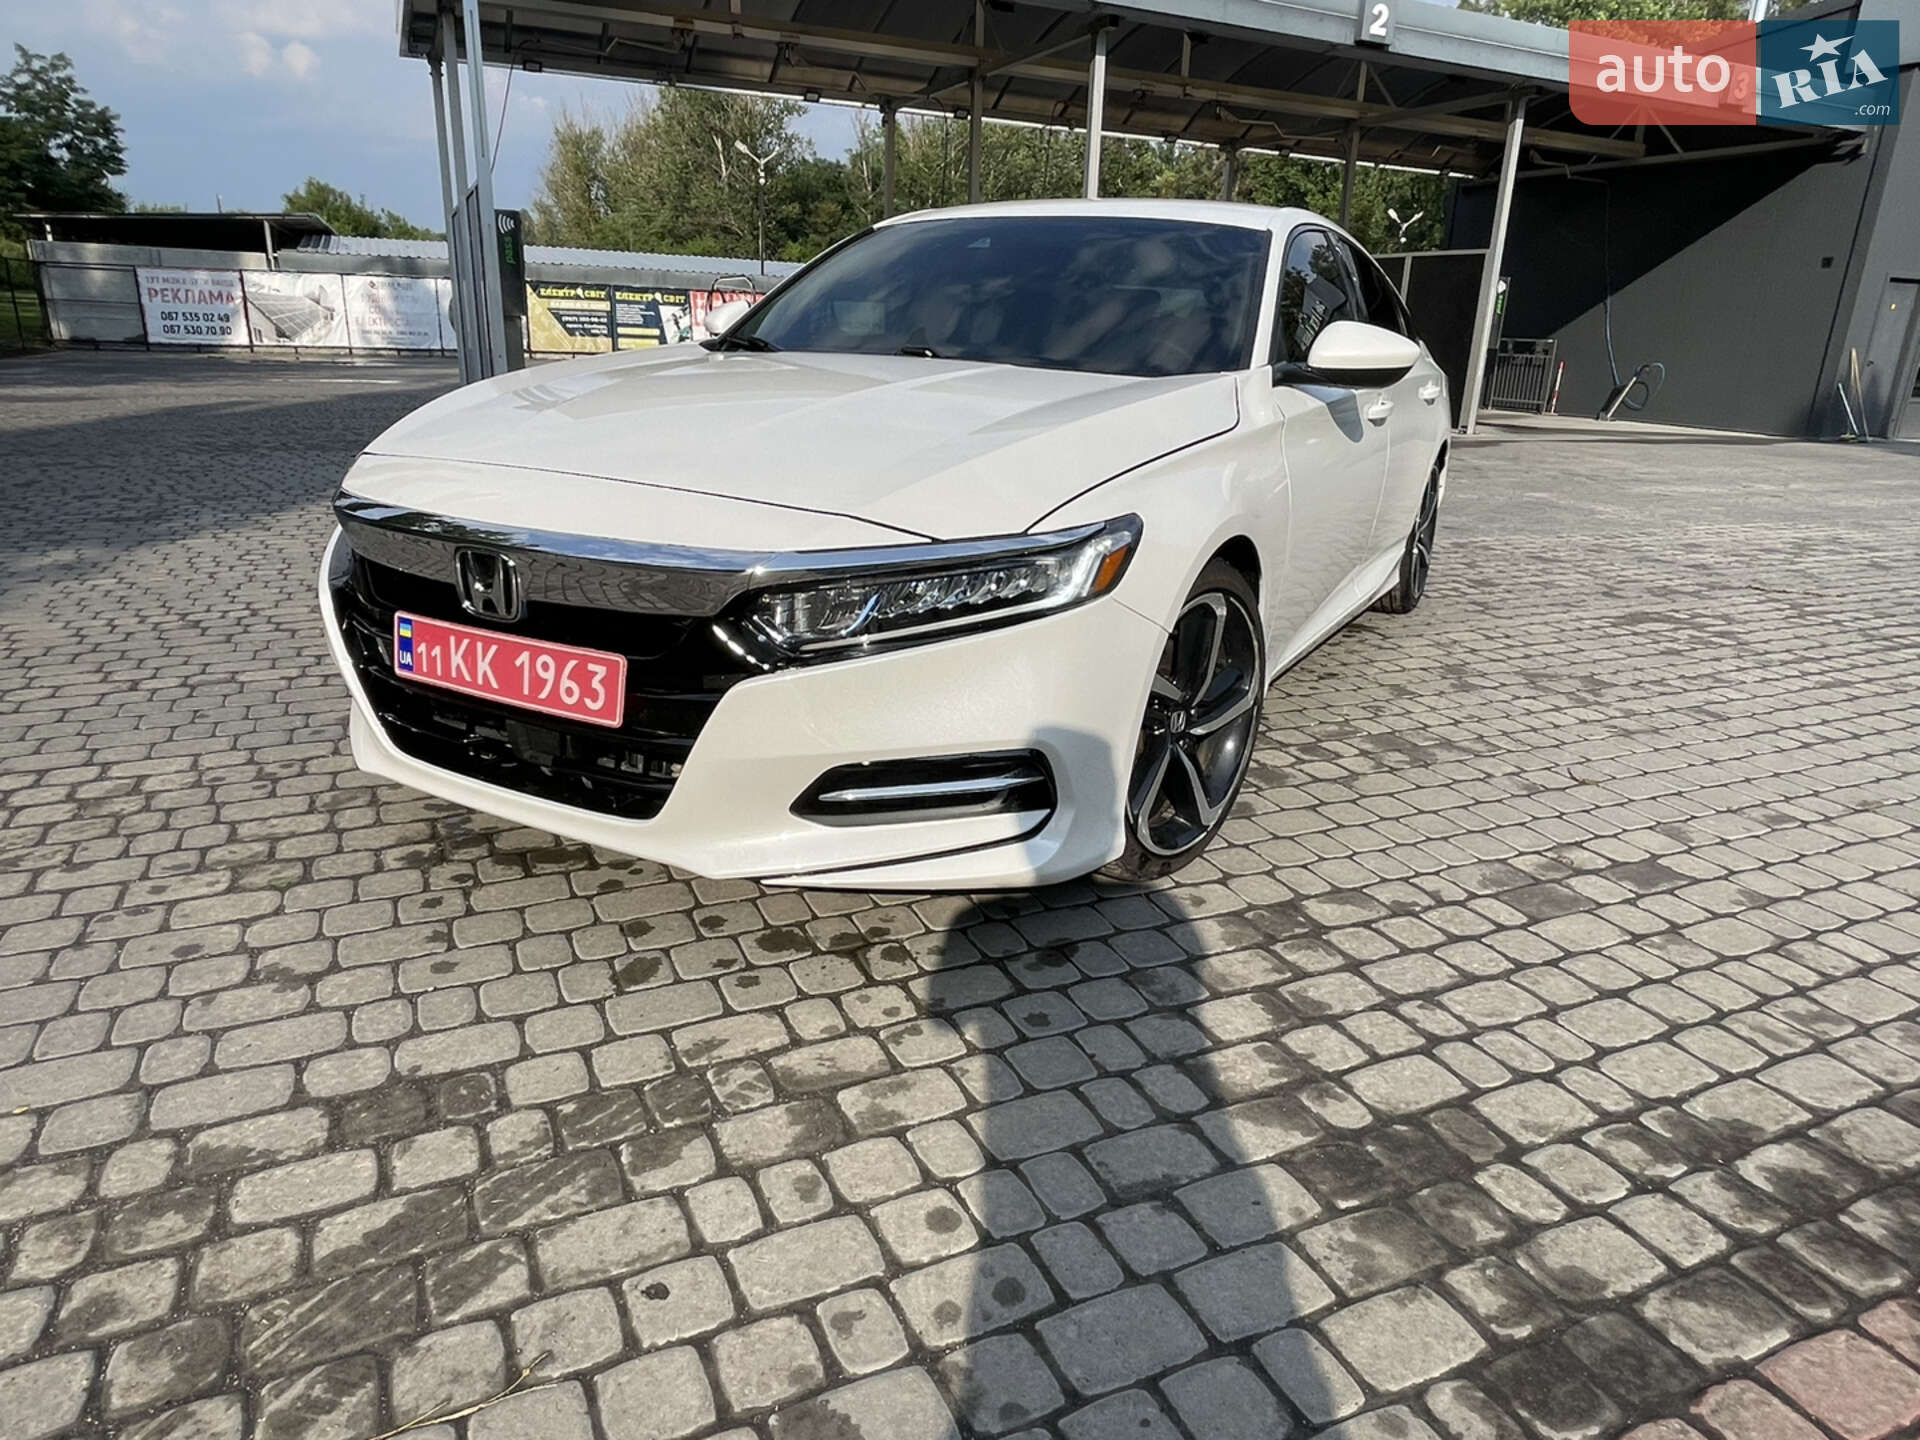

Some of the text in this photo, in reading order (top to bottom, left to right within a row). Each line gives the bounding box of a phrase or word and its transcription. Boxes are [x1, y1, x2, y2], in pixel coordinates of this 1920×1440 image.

[1367, 3, 1390, 37] 2
[147, 287, 236, 305] РЕКЛАМА
[160, 310, 179, 321] 067
[203, 312, 216, 323] 02
[162, 324, 181, 335] 067
[184, 325, 203, 336] 530
[205, 326, 217, 336] 70
[399, 649, 414, 666] UA
[514, 650, 608, 712] 1963
